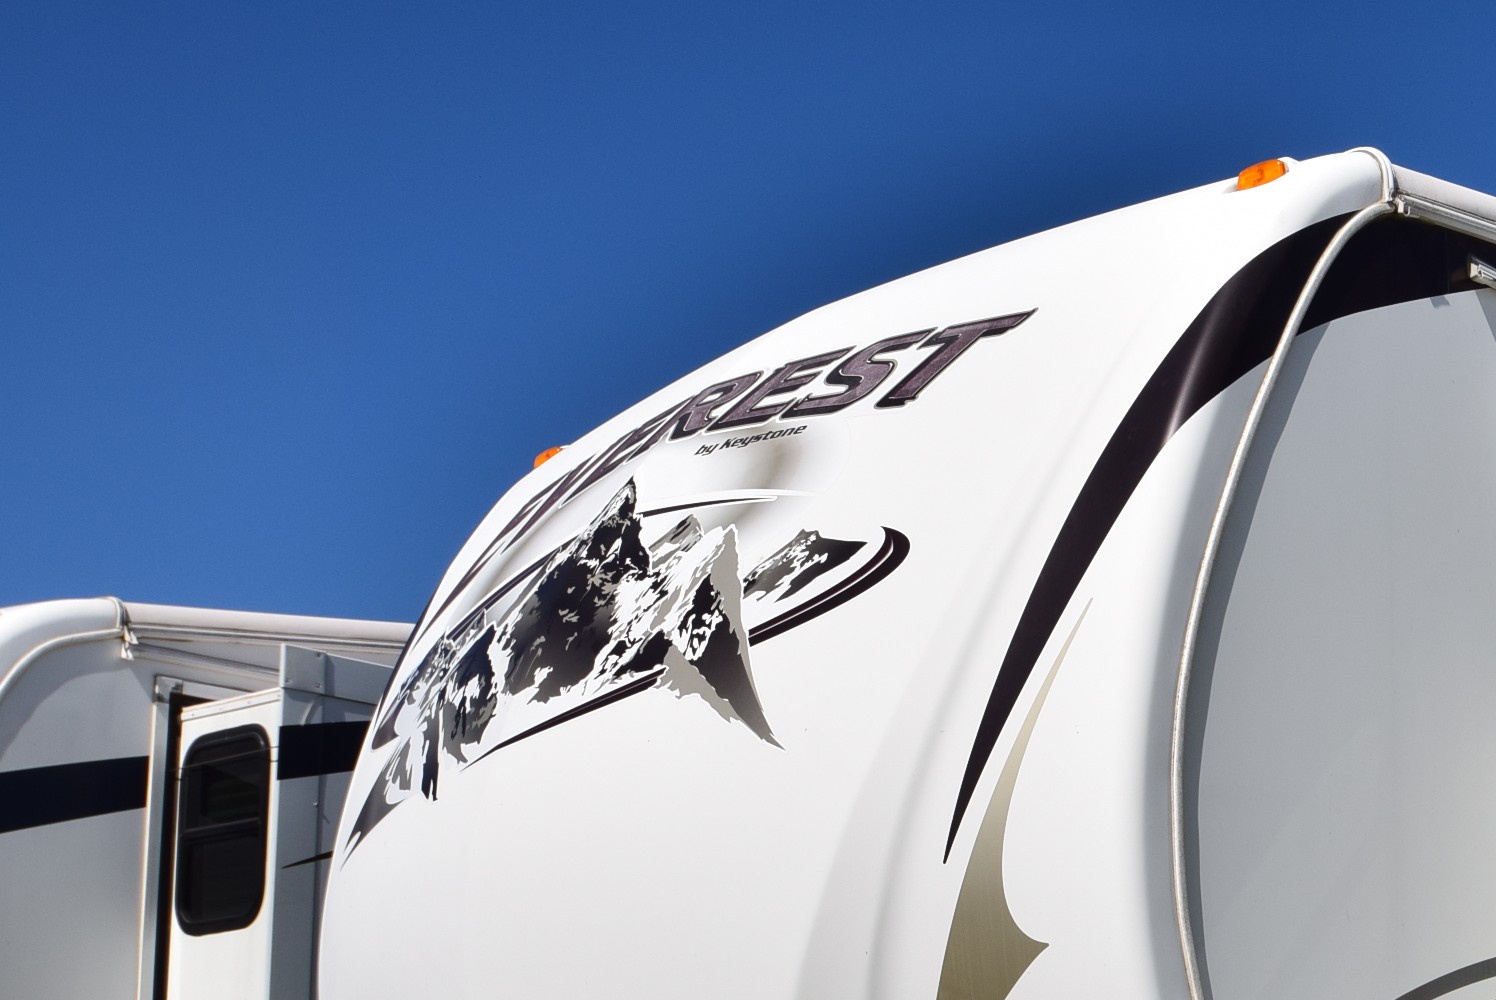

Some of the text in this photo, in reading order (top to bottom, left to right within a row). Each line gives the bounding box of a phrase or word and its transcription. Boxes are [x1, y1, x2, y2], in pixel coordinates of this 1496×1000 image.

[411, 307, 1039, 655] EVEREST
[695, 425, 807, 456] by Keystone
